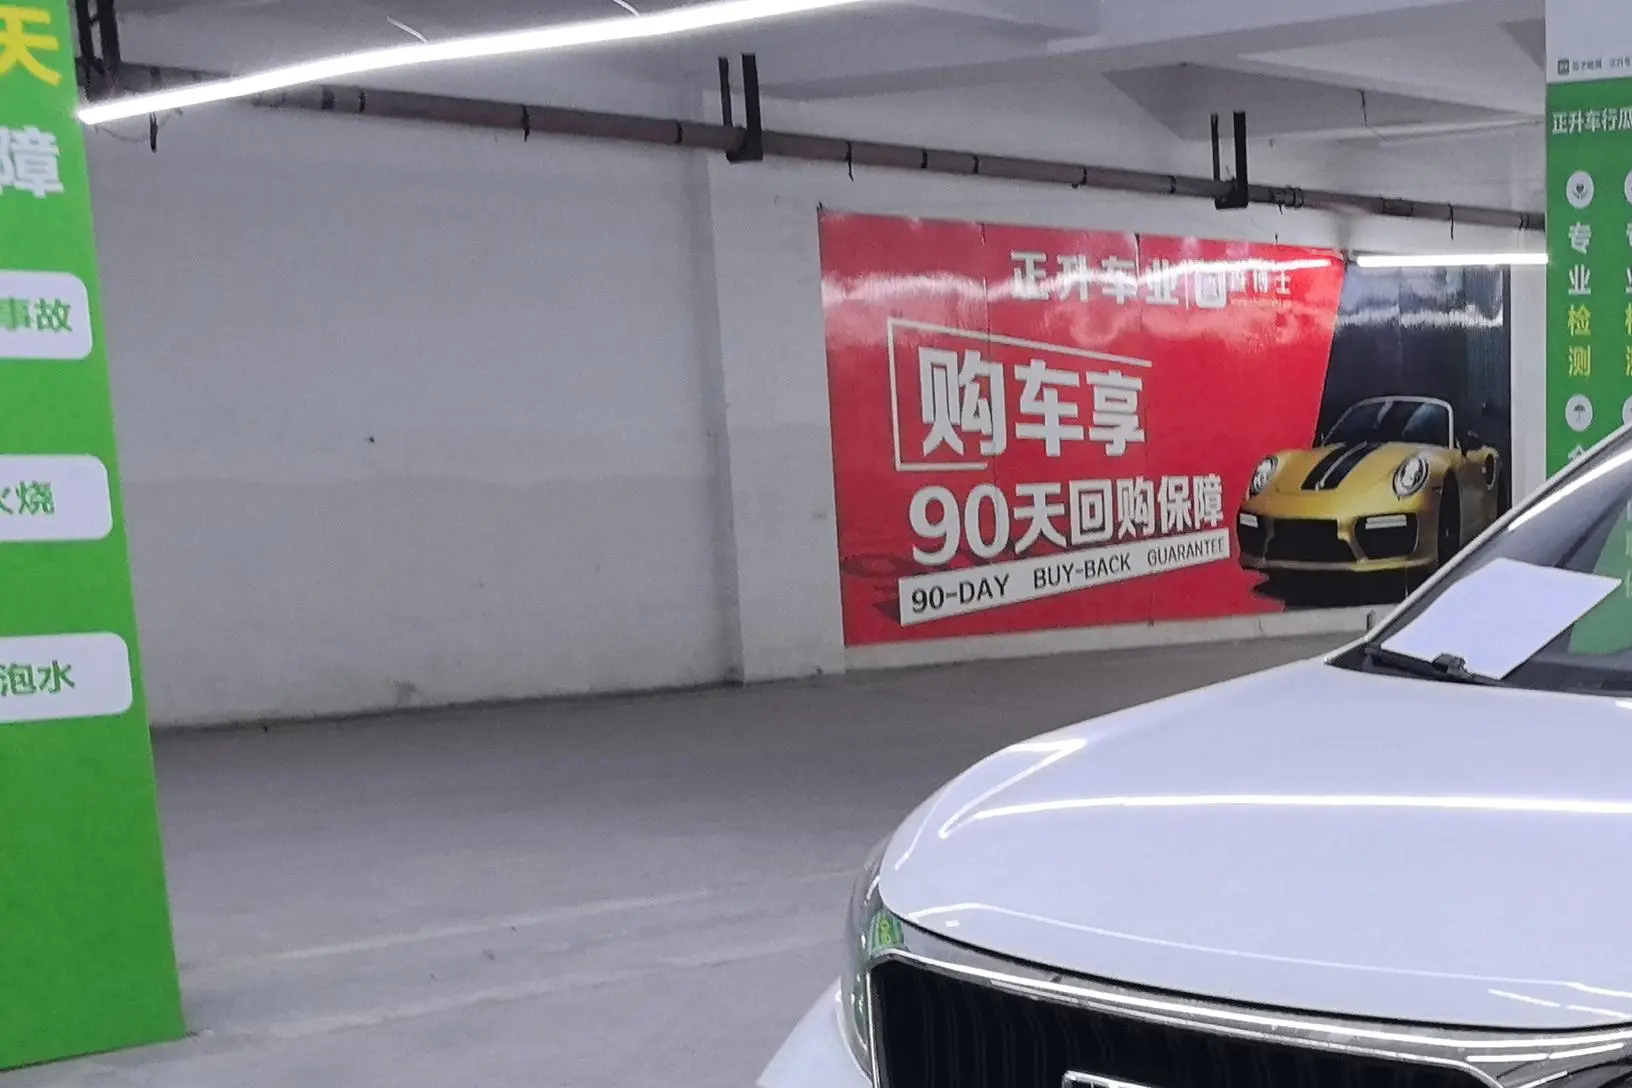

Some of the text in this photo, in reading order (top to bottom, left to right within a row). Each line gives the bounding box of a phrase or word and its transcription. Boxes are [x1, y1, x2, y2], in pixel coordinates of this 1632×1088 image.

[1568, 221, 1592, 377] 专业检测
[919, 346, 1145, 458] 购车享
[910, 473, 1224, 566] 90天回购保障
[910, 535, 1226, 615] 90-DAY BUY-BACK GUARANTEE
